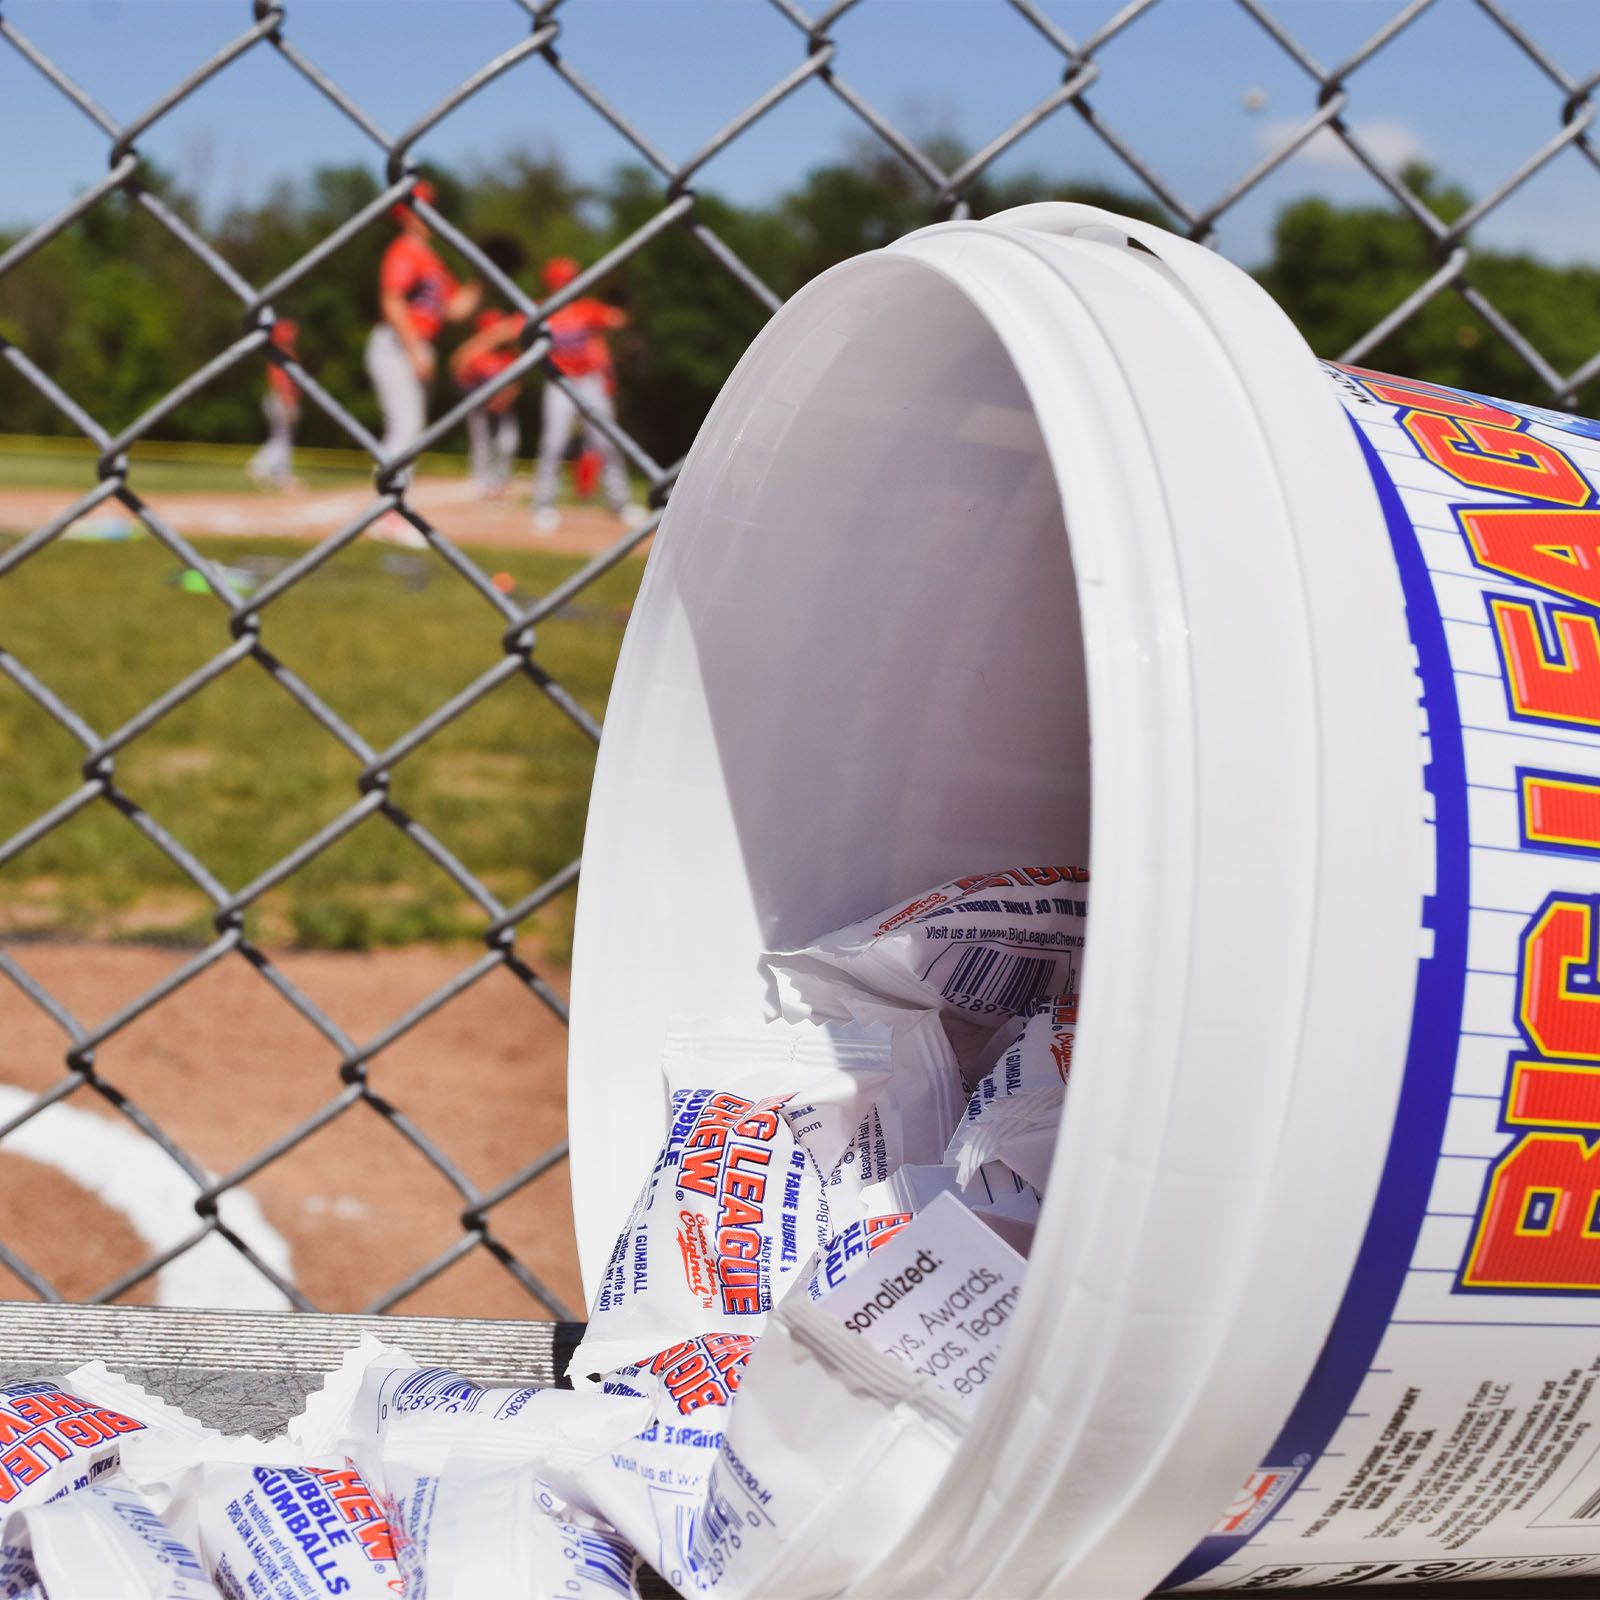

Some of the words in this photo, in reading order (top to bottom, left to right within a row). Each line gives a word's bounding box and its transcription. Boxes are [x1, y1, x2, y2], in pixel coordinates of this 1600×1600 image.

[925, 926, 948, 940] Visit
[951, 927, 964, 940] us
[966, 926, 978, 940] at
[1450, 891, 1600, 1294] BIG
[664, 1089, 716, 1168] BUBBLE
[789, 1150, 806, 1170] OF
[859, 1141, 873, 1180] Baseball
[782, 1171, 803, 1211] FAME
[714, 1141, 774, 1315] LEAGUE
[780, 1212, 800, 1263] BUBBLE
[633, 1235, 648, 1295] GUMBALL
[677, 1210, 710, 1297] Original
[761, 1235, 773, 1263] MADE
[605, 1268, 615, 1281] NY
[613, 1265, 625, 1291] write
[760, 1273, 771, 1290] THE
[599, 1283, 612, 1312] 14001
[613, 1293, 626, 1306] to:
[760, 1291, 772, 1312] USA
[917, 1266, 1004, 1336] Awards,
[664, 1353, 730, 1416] BIG
[55, 1408, 149, 1449] BIG
[1345, 1444, 1390, 1487] MACHINE
[1377, 1385, 1421, 1441] COMPANY
[1395, 1453, 1421, 1471] THE
[1410, 1428, 1436, 1450] USA
[641, 1466, 656, 1481] us
[251, 1466, 351, 1596] GUMBALLS
